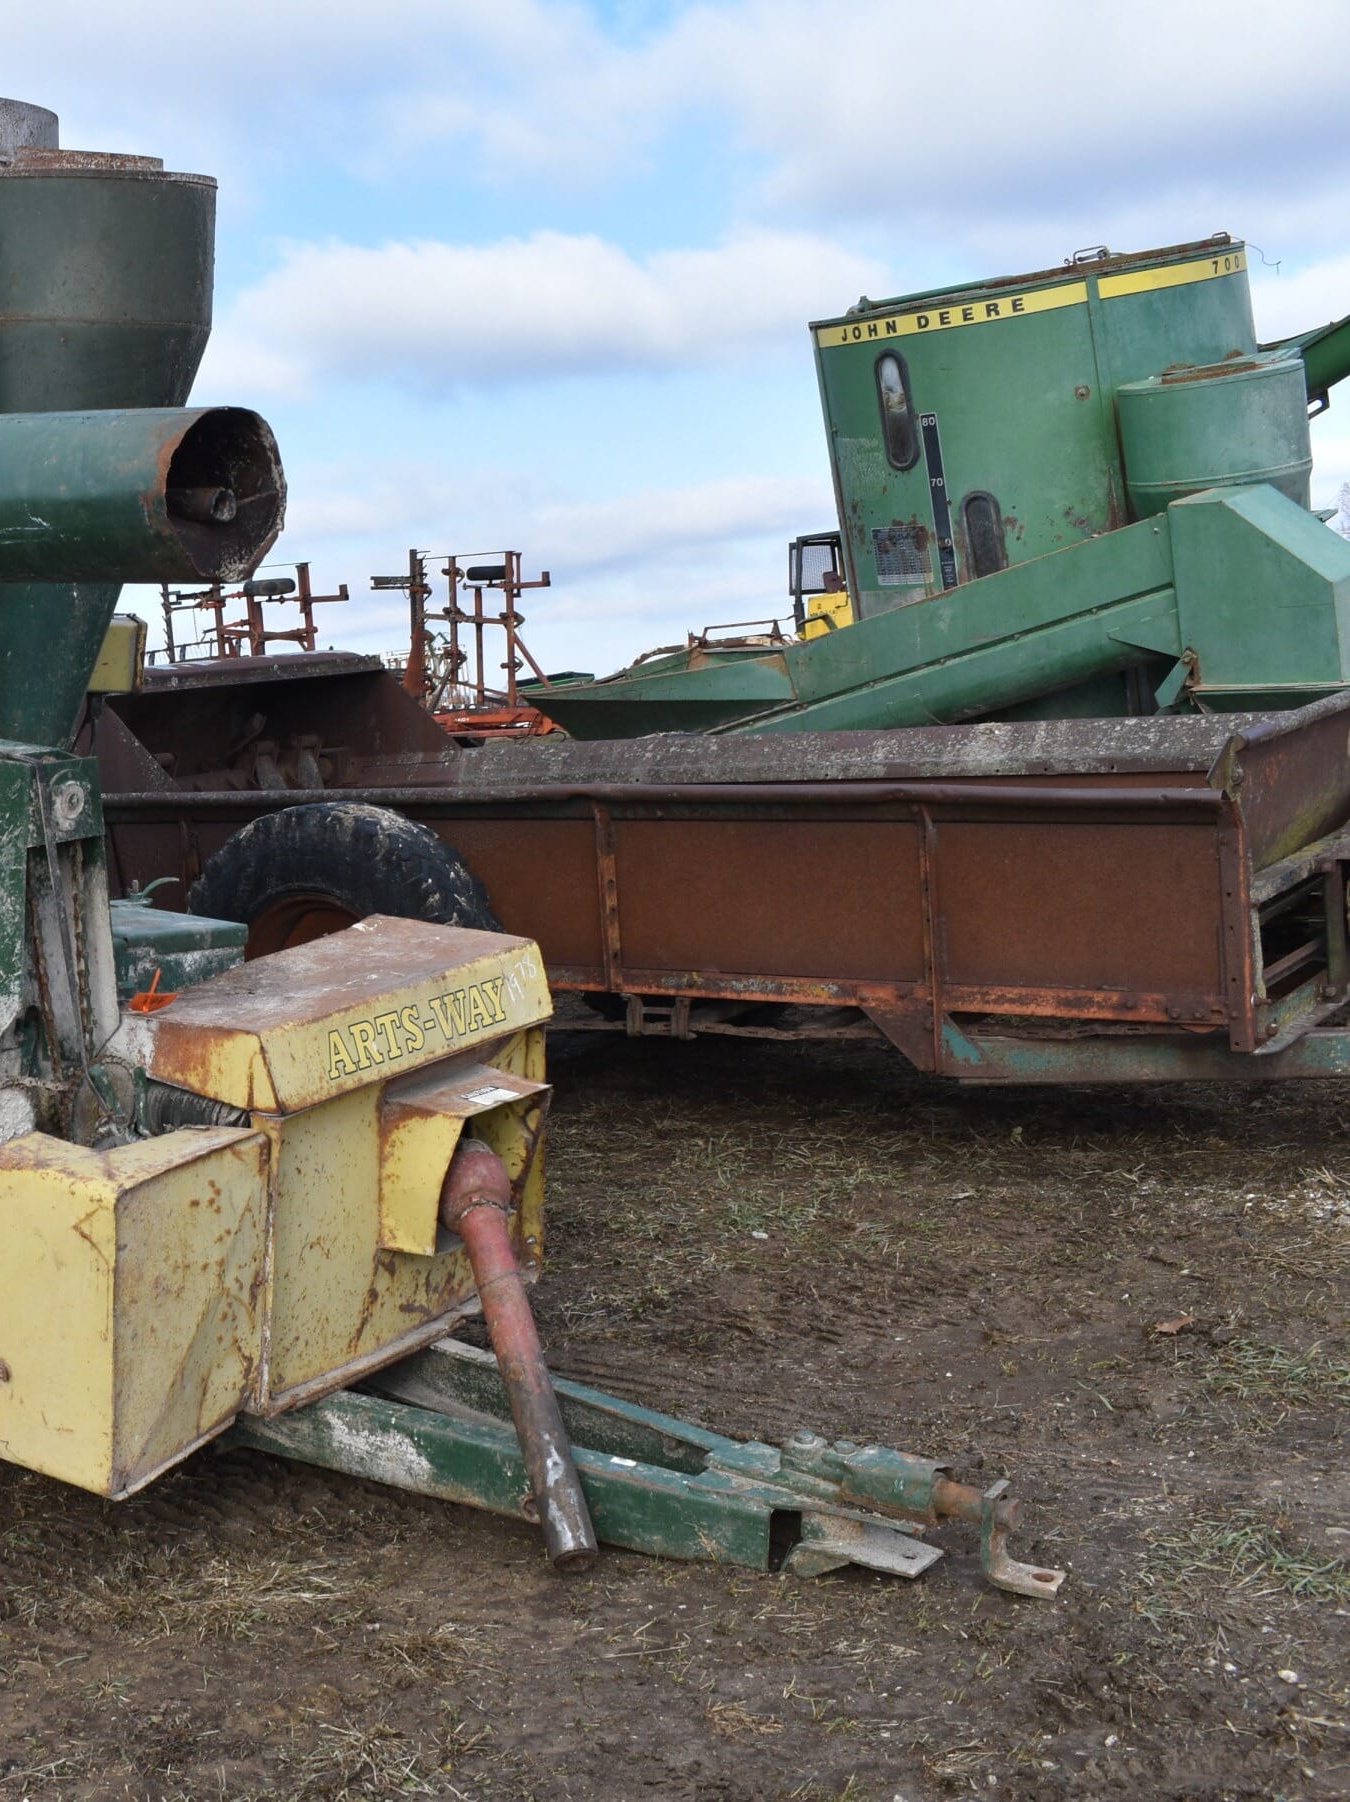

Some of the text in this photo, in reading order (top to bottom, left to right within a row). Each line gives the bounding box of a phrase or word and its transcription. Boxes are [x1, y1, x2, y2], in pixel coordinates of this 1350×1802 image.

[1212, 255, 1240, 275] 700
[841, 297, 1025, 342] JOHN DEERE
[922, 416, 936, 427] 80
[931, 477, 944, 487] 70
[328, 976, 507, 1080] ARTS-WAY
